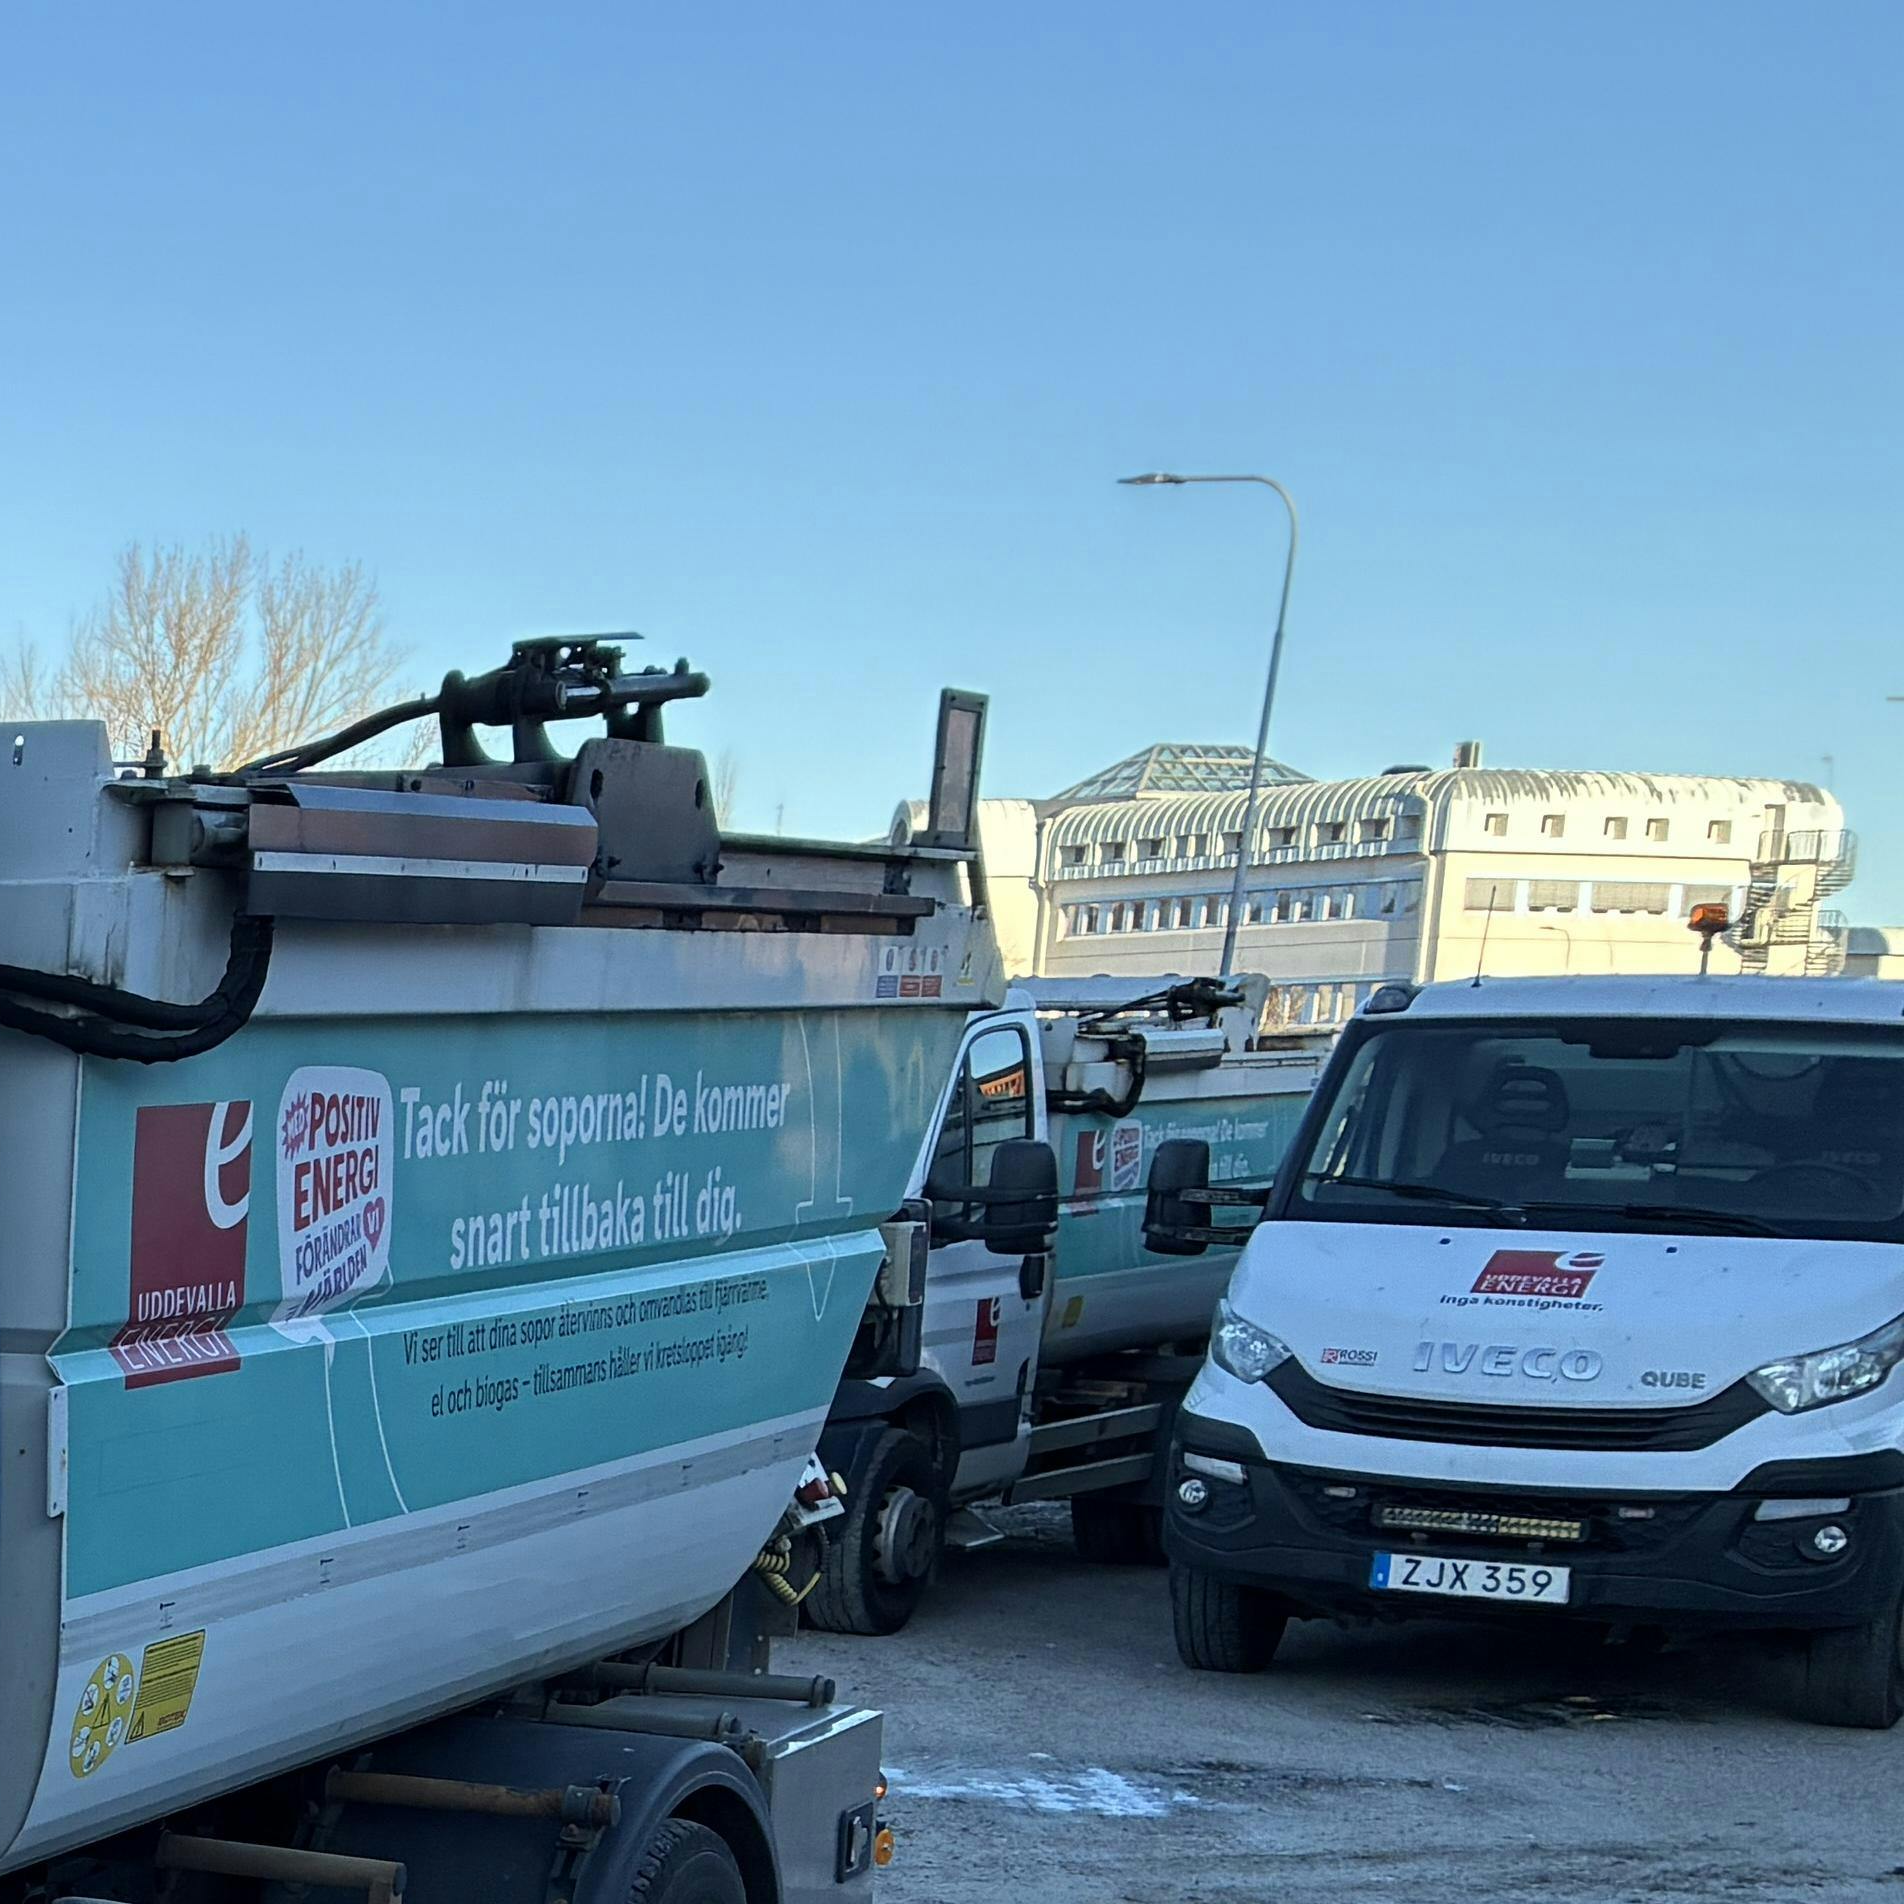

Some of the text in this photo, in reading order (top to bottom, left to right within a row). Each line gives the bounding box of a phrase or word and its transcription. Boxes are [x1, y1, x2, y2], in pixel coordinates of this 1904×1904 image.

[308, 1092, 380, 1151] POSITIV
[400, 1070, 791, 1167] Tack för soporna! De kommer
[294, 1145, 380, 1232] ENERGI
[450, 1167, 742, 1269] snart tillbaka till dig.
[138, 1281, 237, 1322] UDDEVALLA
[1440, 1295, 1479, 1307] Inga
[1480, 1280, 1580, 1296] ENERGI
[118, 1316, 228, 1370] ENERGI
[404, 1330, 418, 1365] Vi
[422, 1334, 444, 1363] ser
[447, 1325, 465, 1358] till
[468, 1324, 486, 1354] att
[489, 1317, 517, 1349] dina
[520, 1316, 555, 1349] sopor
[616, 1295, 636, 1327] och
[1339, 1349, 1379, 1362] ROSSI
[1413, 1342, 1604, 1382] IVECO
[431, 1384, 444, 1417] el
[447, 1379, 472, 1414] och
[476, 1375, 519, 1411] biogas
[533, 1358, 606, 1396] tillsammans
[1640, 1370, 1707, 1389] QUBE
[1402, 1558, 1552, 1597] ZJX 359
